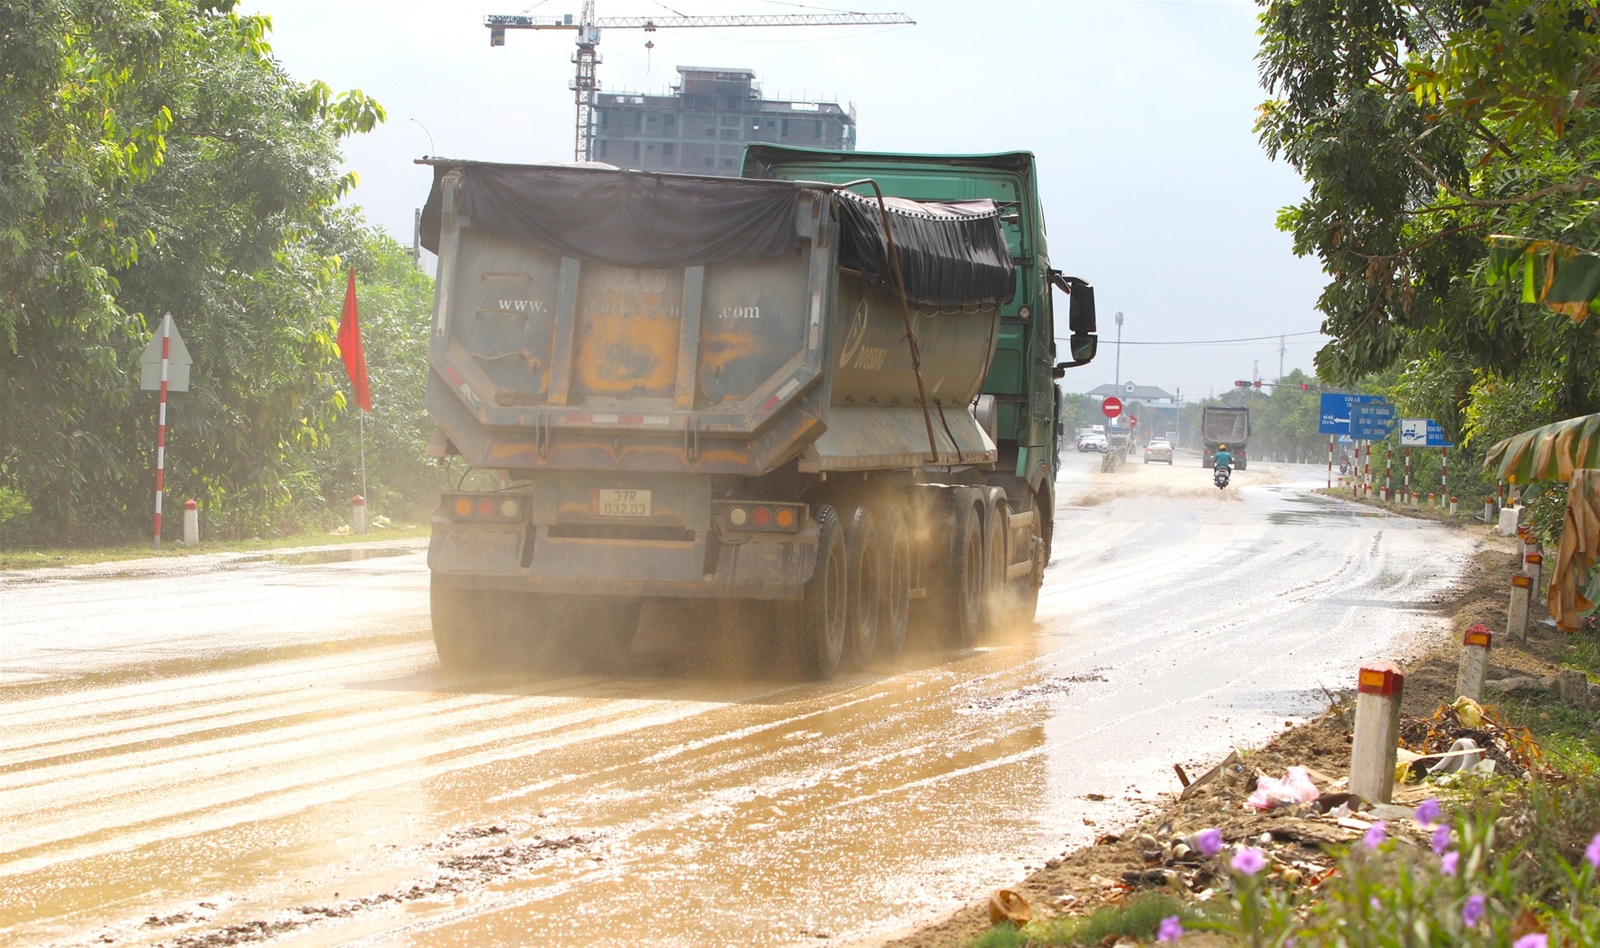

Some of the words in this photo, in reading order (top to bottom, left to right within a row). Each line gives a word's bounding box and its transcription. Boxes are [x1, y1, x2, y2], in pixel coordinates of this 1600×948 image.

[498, 298, 549, 313] www.
[717, 304, 761, 319] .com
[614, 490, 637, 503] 37R
[604, 503, 646, 515] 032.03
